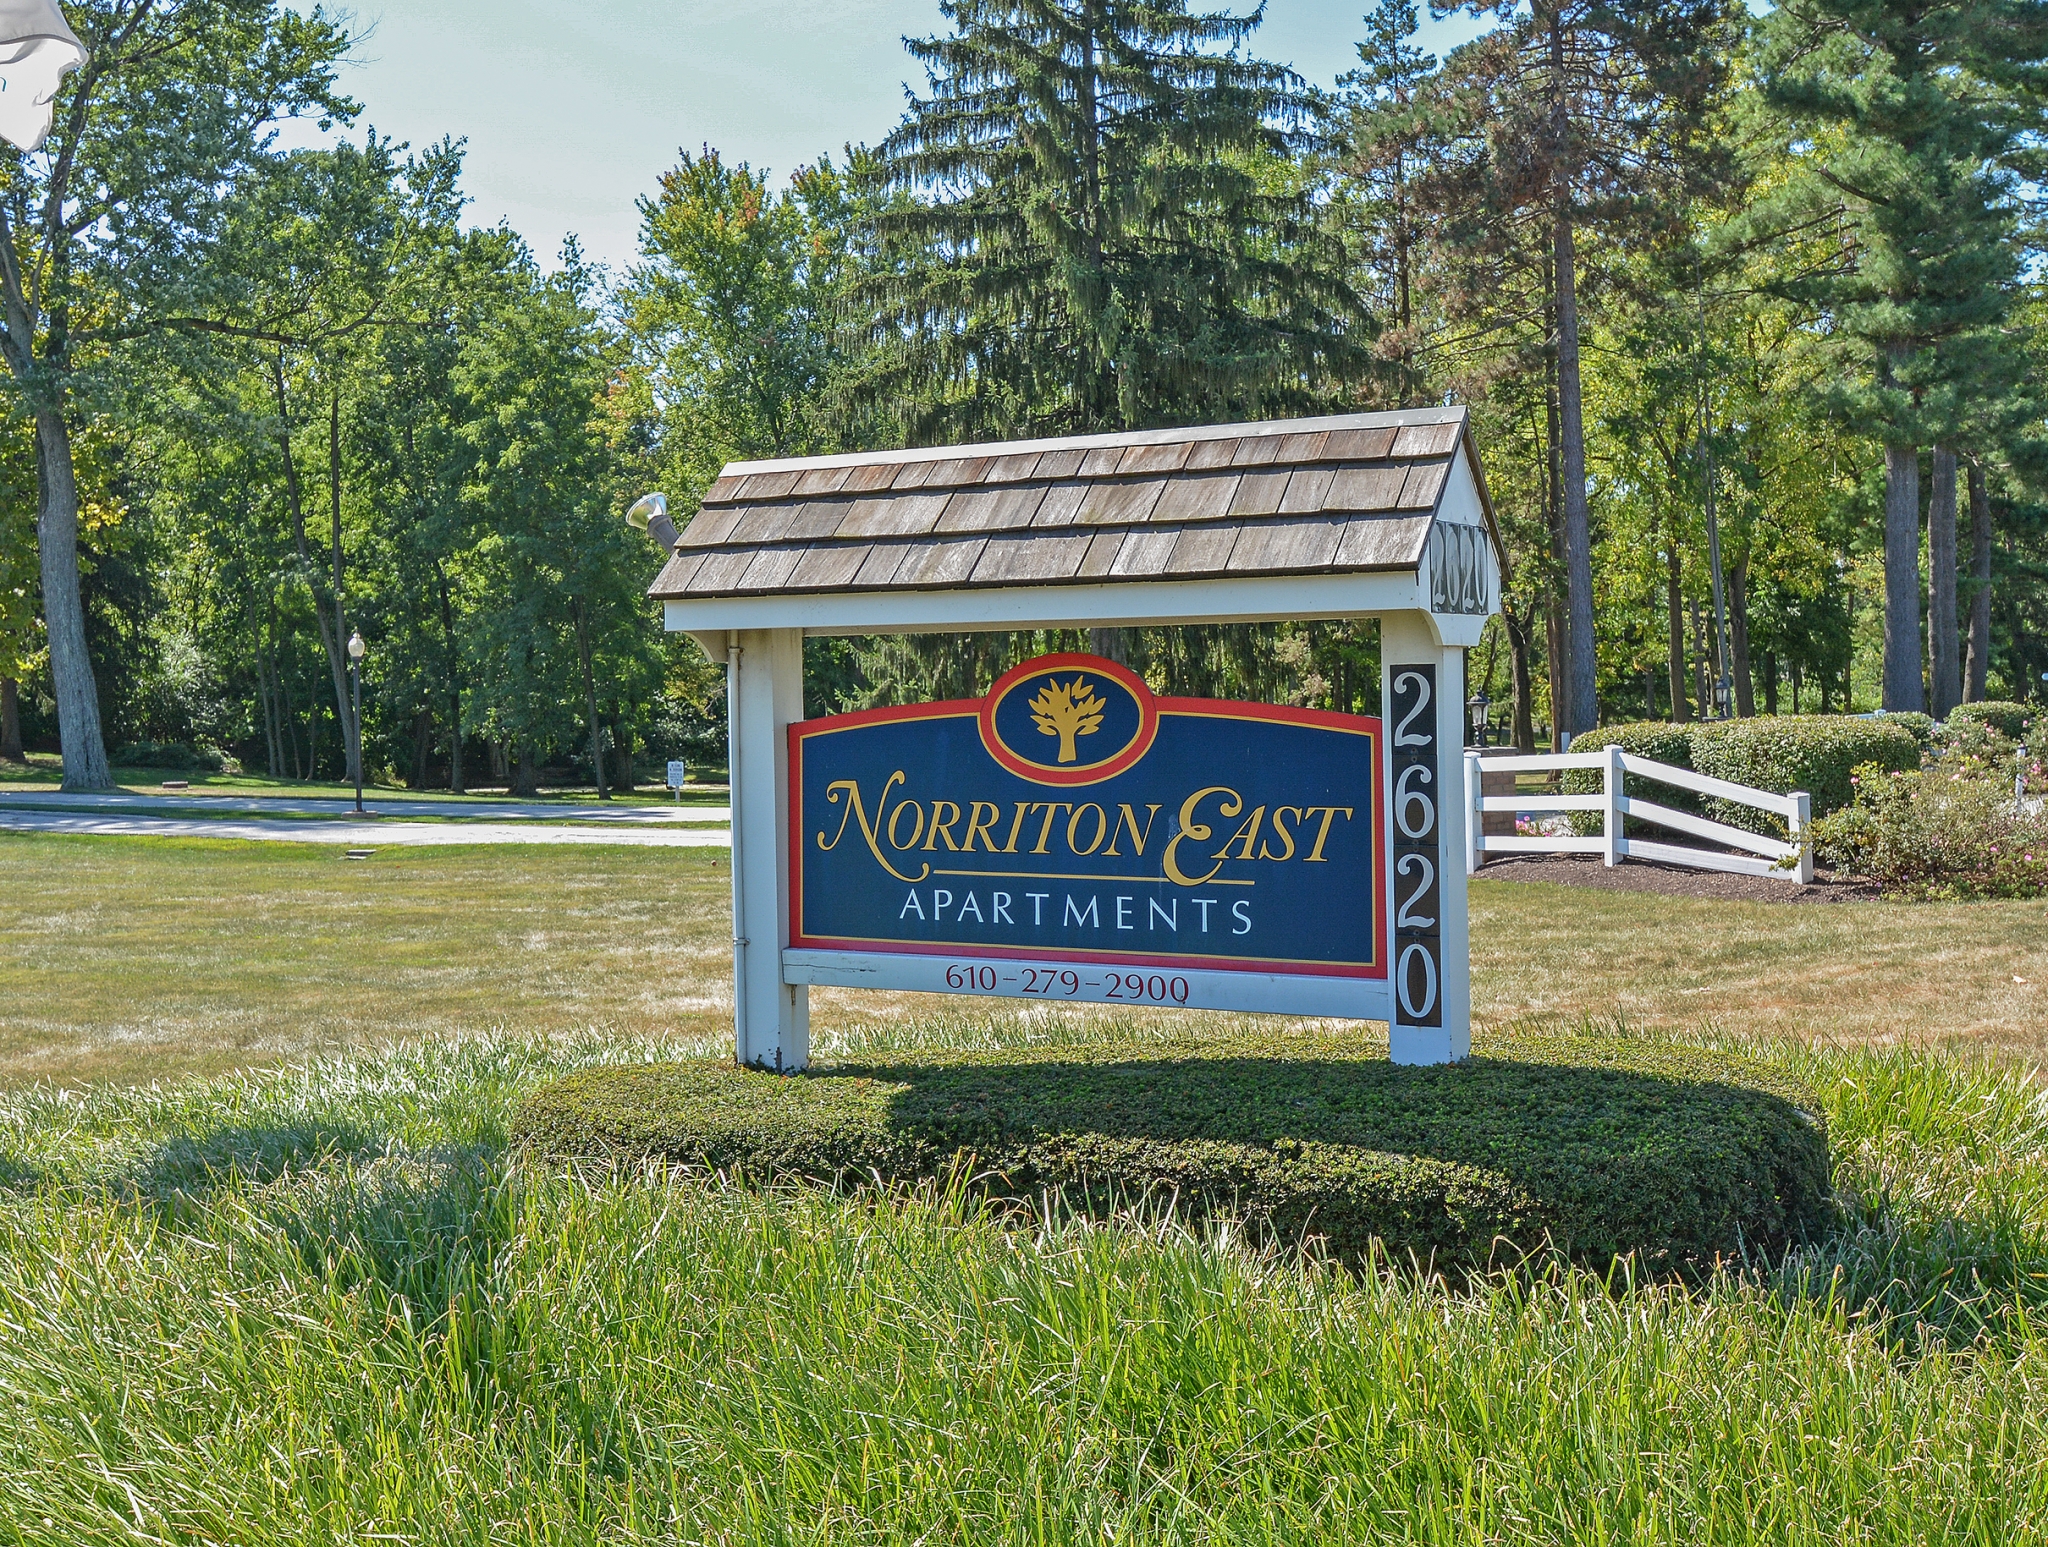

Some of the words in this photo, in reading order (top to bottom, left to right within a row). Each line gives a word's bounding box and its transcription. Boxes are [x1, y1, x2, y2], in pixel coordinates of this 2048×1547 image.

[1431, 521, 1488, 612] 2620
[817, 769, 1162, 882] NORRITON
[1163, 785, 1353, 887] EAST
[1393, 671, 1438, 1018] 2620
[899, 888, 1252, 935] APARTMENTS
[945, 963, 1190, 1004] 610-279-2900
